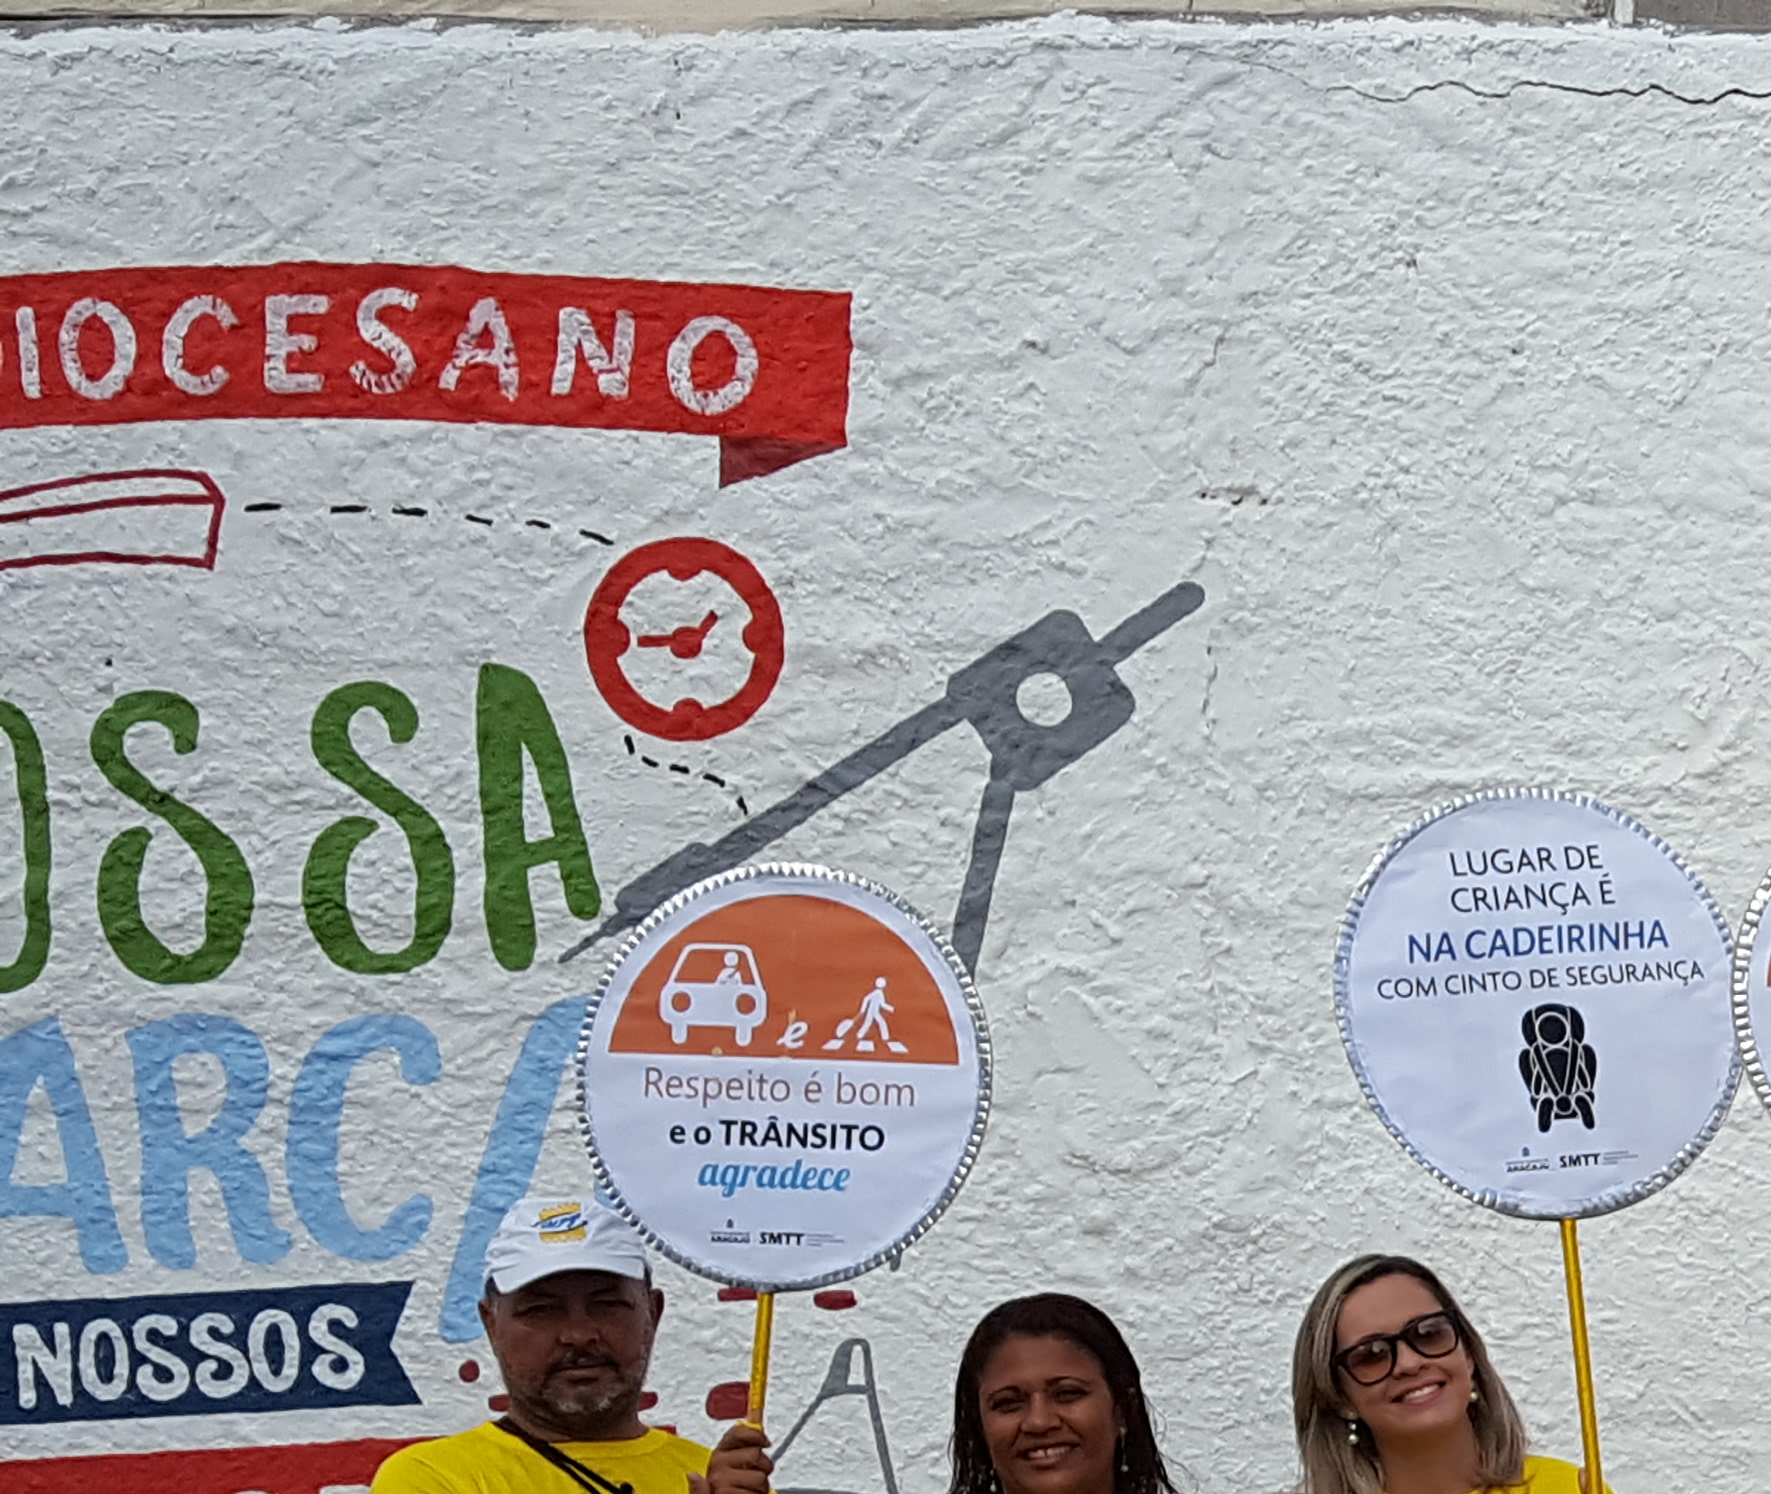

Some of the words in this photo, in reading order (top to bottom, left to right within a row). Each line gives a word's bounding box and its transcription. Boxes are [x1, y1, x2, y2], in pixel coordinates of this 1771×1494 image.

[0, 287, 759, 415] IOCESANO
[1450, 847, 1556, 876] LUGAR
[1564, 845, 1603, 870] DE
[1451, 882, 1591, 915] CRIANÇA
[1599, 873, 1615, 904] É
[1409, 932, 1456, 963] NA
[1465, 920, 1668, 959] CADEIRINHA
[1378, 977, 1437, 999] COM
[1445, 971, 1521, 995] CINTO
[1530, 968, 1559, 988] DE
[1566, 961, 1704, 986] SEGURANÇA
[645, 1067, 790, 1108] Respeito
[804, 1071, 822, 1103] é
[837, 1072, 914, 1106] bom
[670, 1126, 685, 1144] e
[694, 1126, 711, 1145] o
[719, 1116, 884, 1151] TRÂNSITO
[698, 1159, 850, 1197] agradece
[1560, 1153, 1601, 1168] SMTT
[759, 1231, 804, 1245] SMTT
[13, 1303, 366, 1410] NOSSOS
